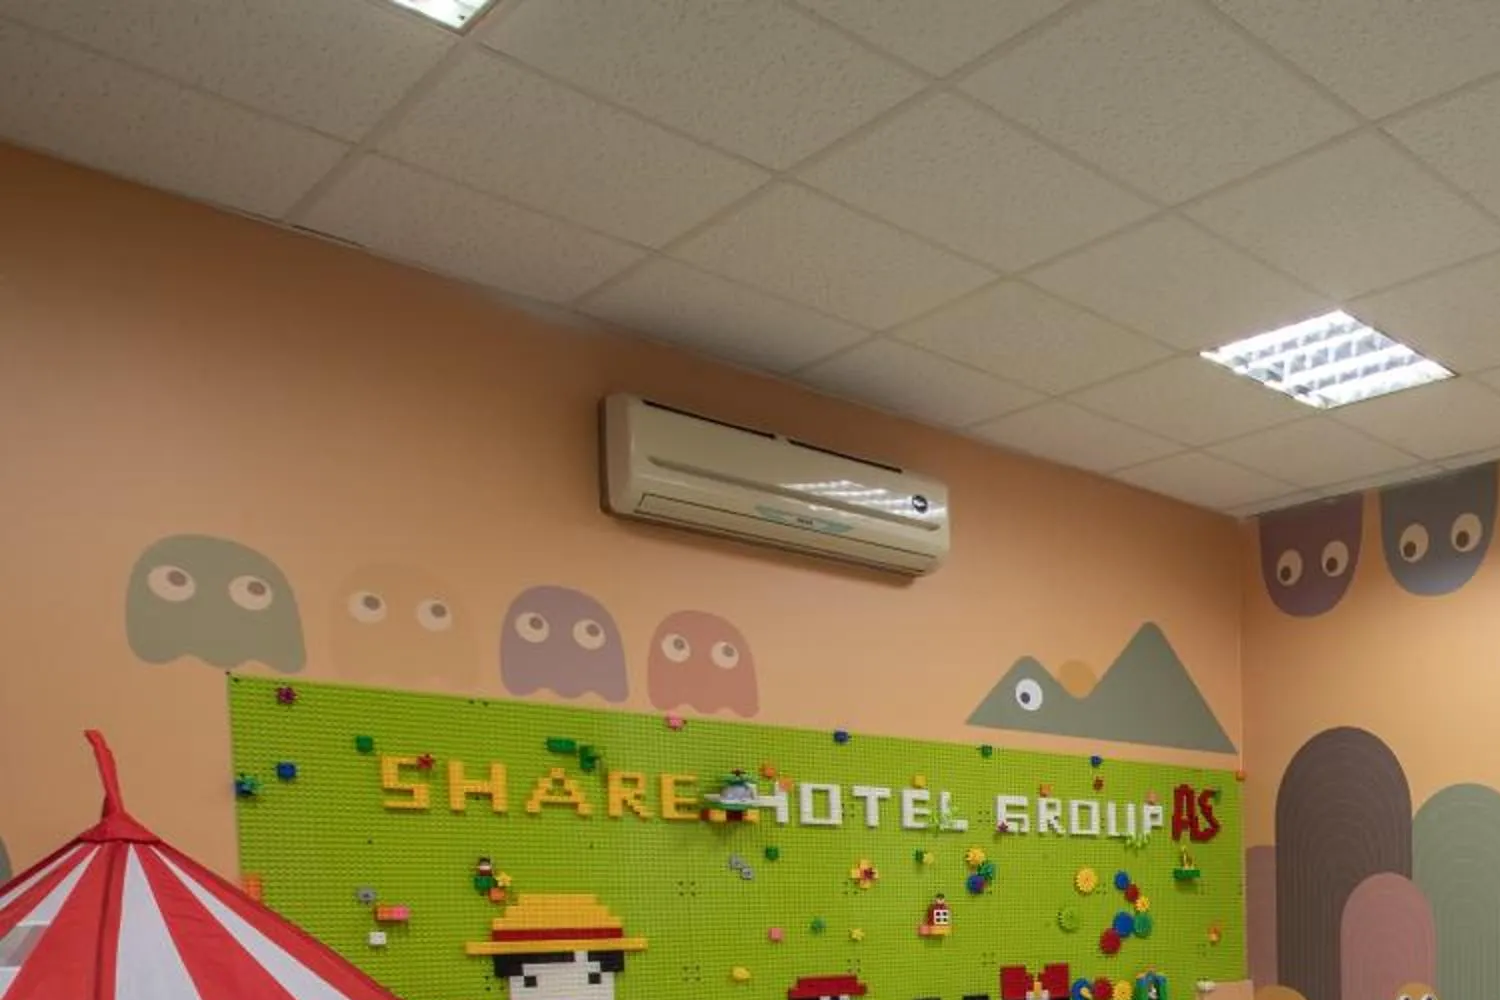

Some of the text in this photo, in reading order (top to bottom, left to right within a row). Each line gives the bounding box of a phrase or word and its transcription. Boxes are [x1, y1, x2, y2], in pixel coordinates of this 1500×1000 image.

[381, 754, 1221, 843] SHARE HOTEL GROUP AS
